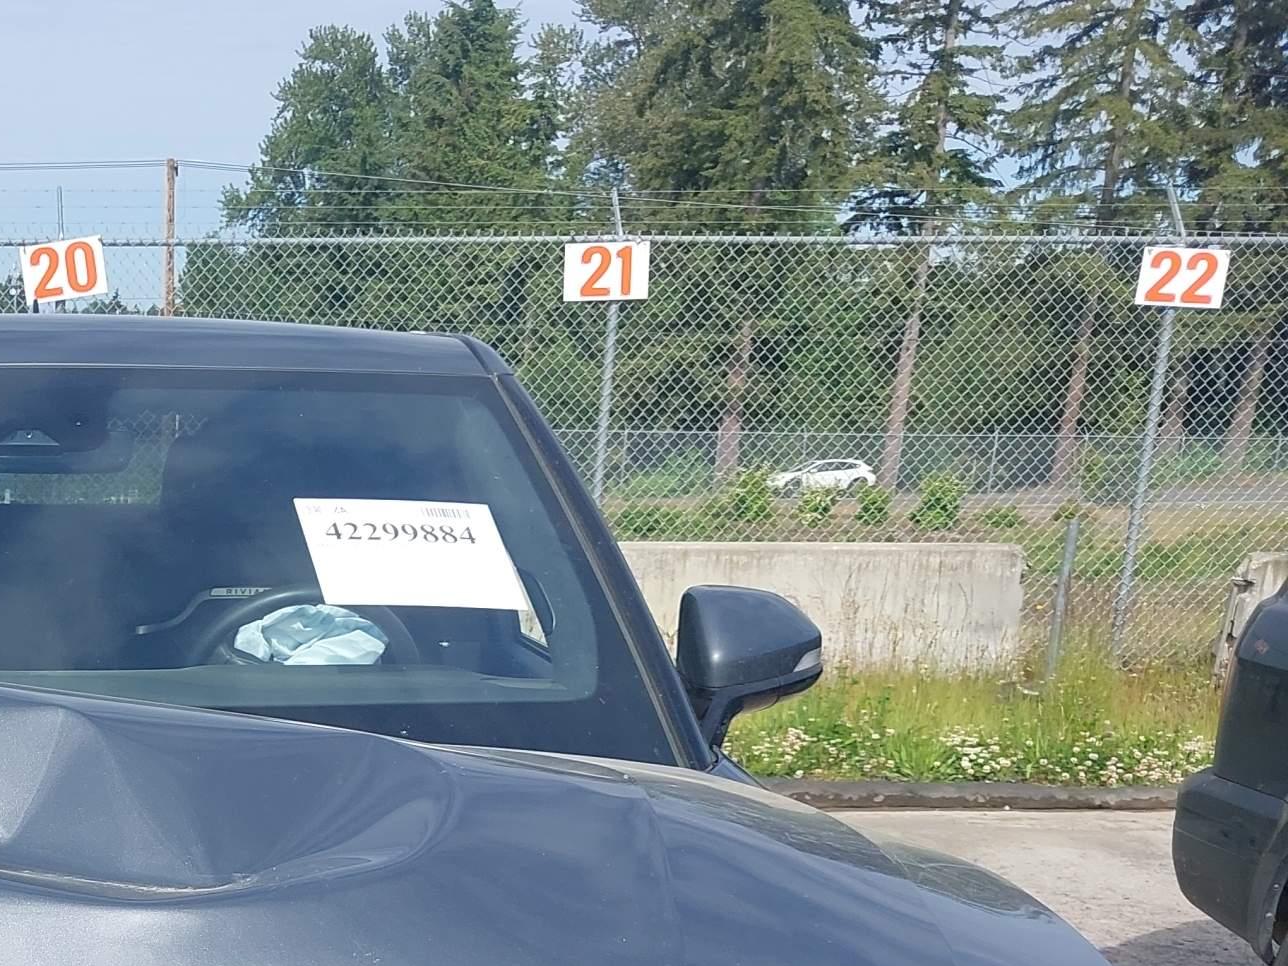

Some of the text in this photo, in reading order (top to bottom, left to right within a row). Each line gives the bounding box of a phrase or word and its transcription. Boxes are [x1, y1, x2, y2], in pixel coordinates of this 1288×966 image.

[29, 242, 98, 299] 20
[579, 245, 633, 298] 21
[1144, 251, 1219, 304] 22
[325, 521, 477, 545] 42299884
